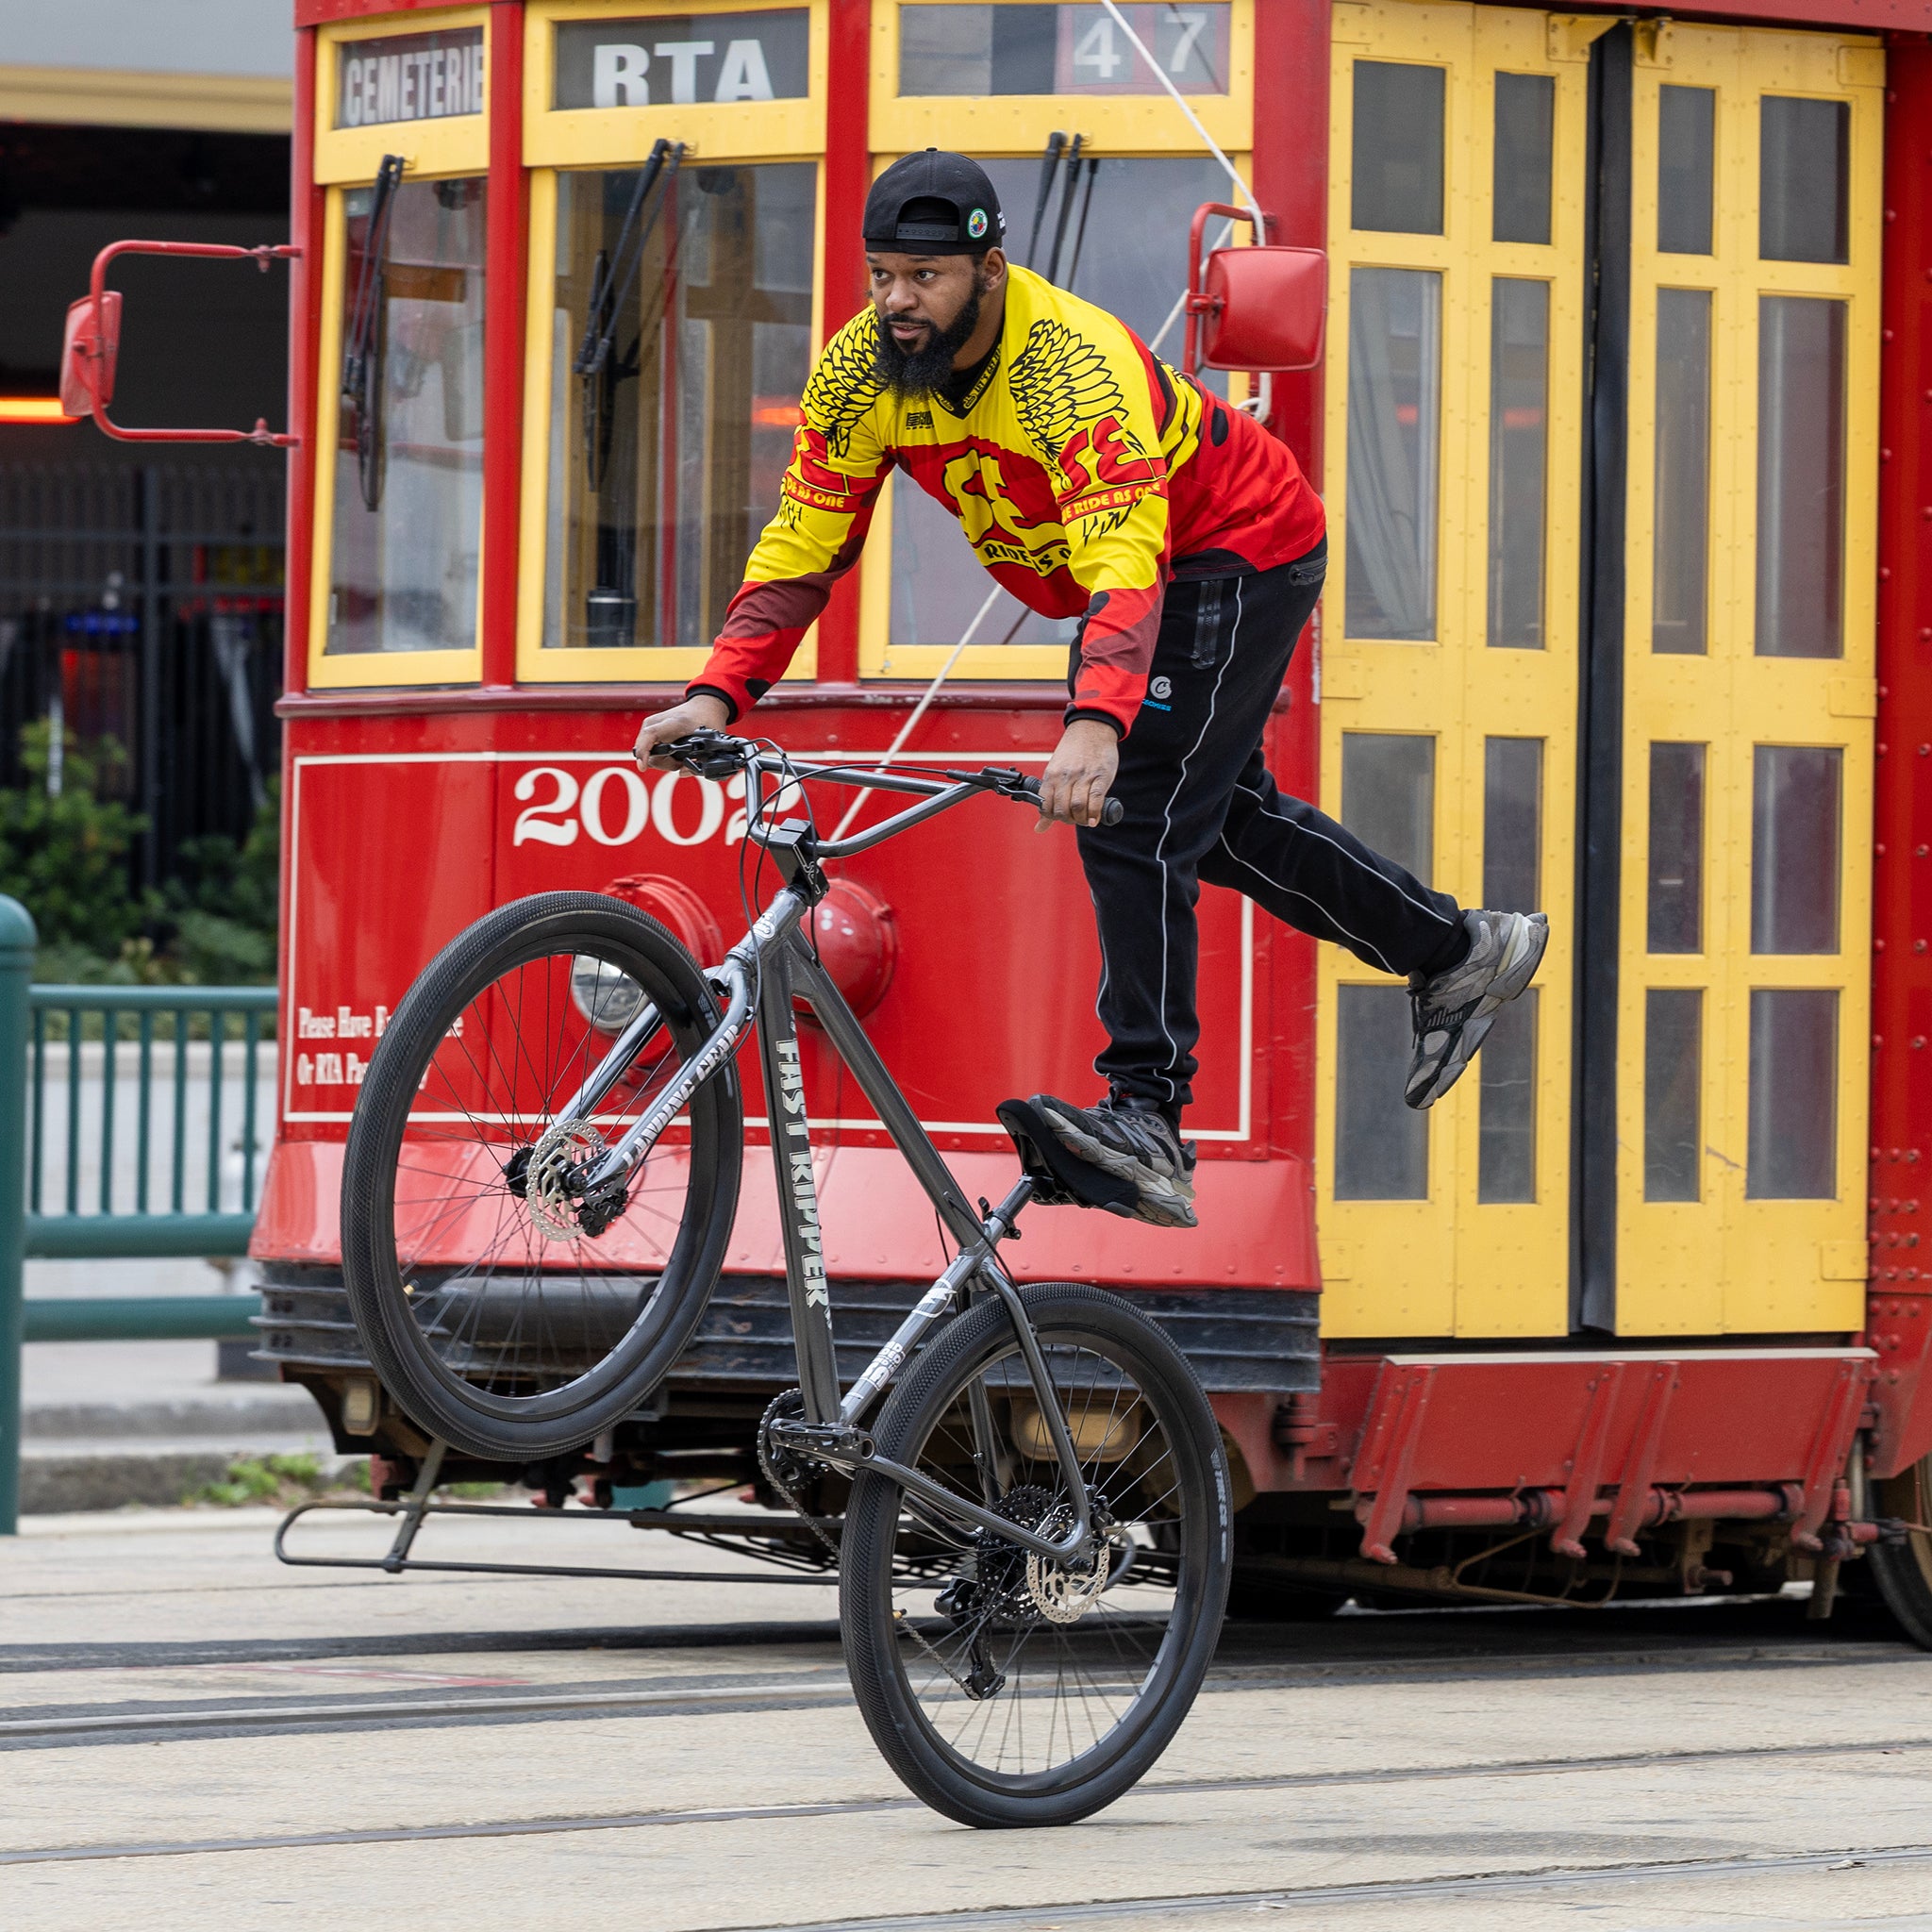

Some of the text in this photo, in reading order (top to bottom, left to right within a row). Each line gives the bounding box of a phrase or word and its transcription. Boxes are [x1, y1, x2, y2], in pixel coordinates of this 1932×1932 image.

[593, 40, 774, 108] RTA
[813, 491, 845, 508] ONE
[1073, 493, 1110, 514] RIDE
[1112, 489, 1132, 504] AS
[984, 542, 1032, 564] RIDE
[513, 766, 802, 847] 2002
[775, 1038, 809, 1141] FAST
